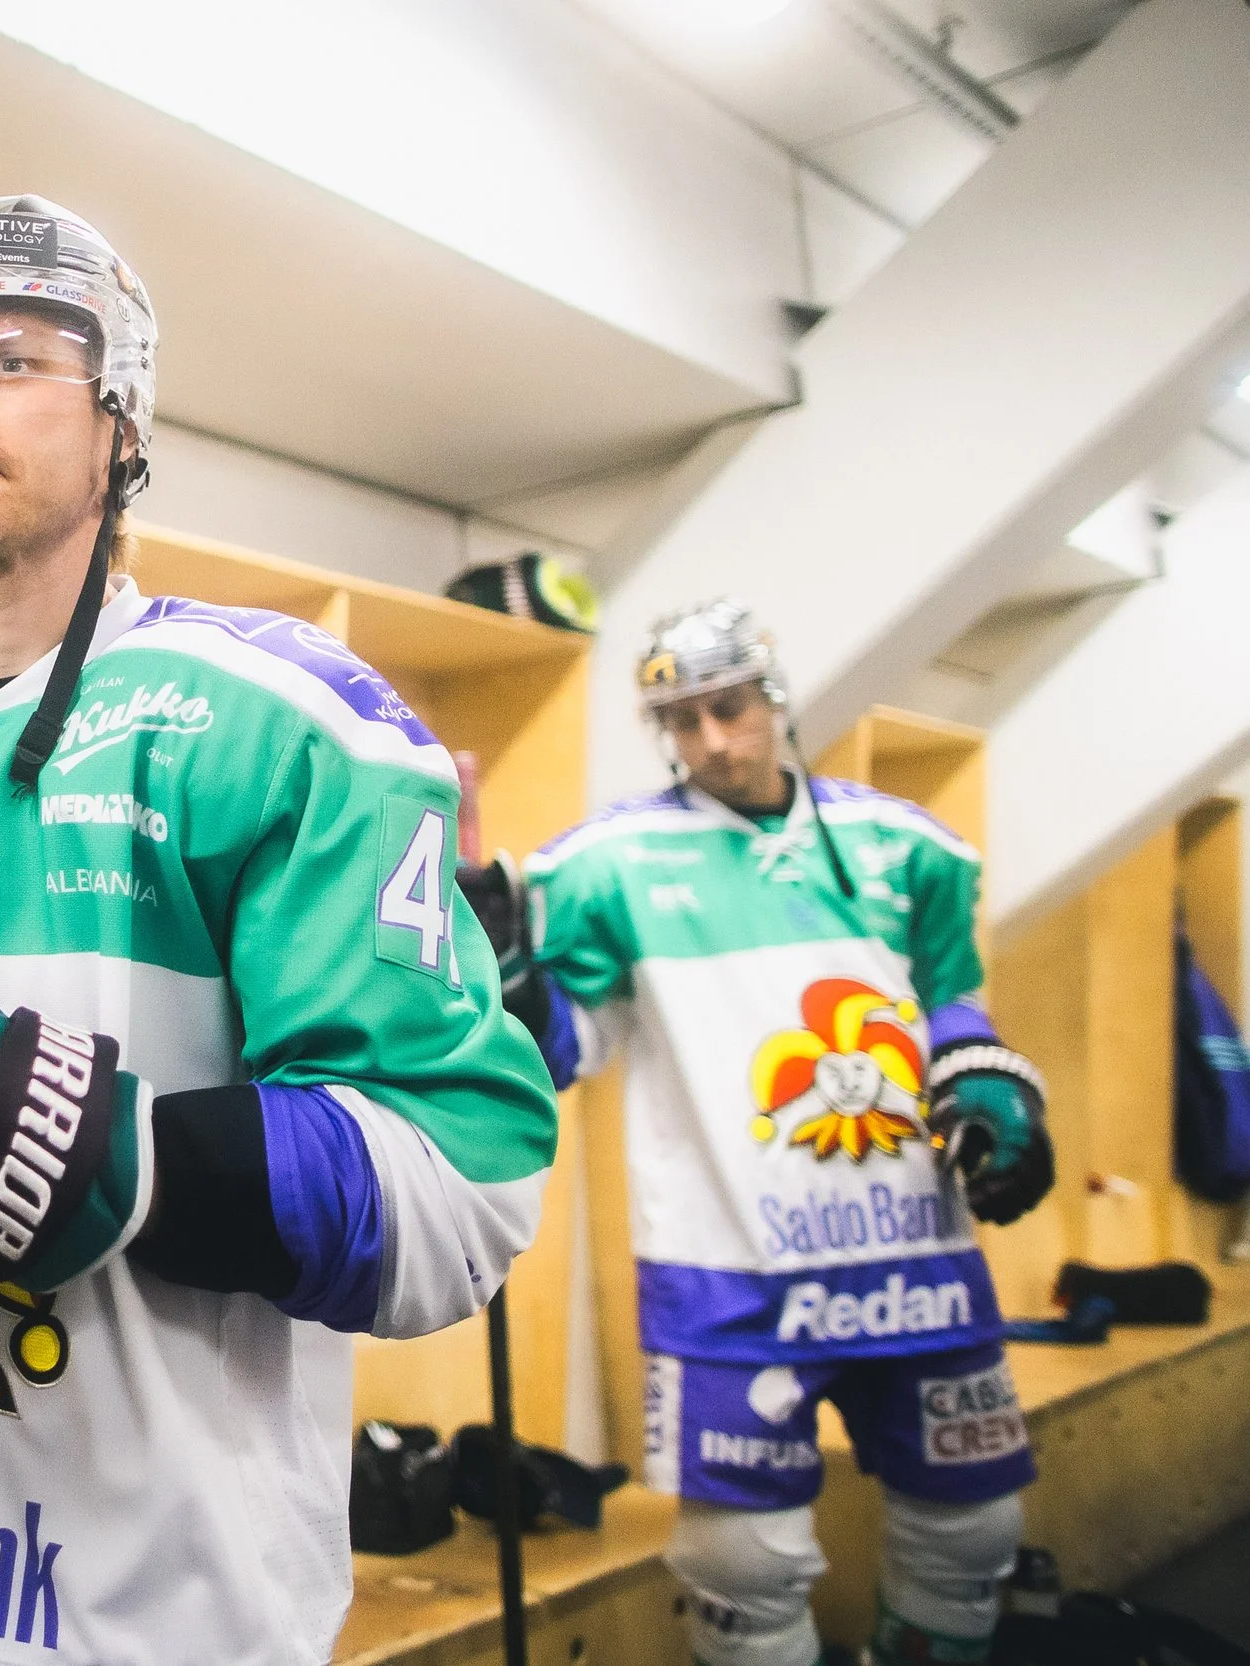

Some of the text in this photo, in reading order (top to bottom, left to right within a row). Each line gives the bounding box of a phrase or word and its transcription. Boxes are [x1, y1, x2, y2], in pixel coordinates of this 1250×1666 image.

[45, 284, 107, 315] GLASSDRIVE
[58, 681, 214, 756] Kukko
[146, 747, 174, 768] OLUT
[377, 807, 463, 988] 4
[777, 1273, 972, 1342] Redan
